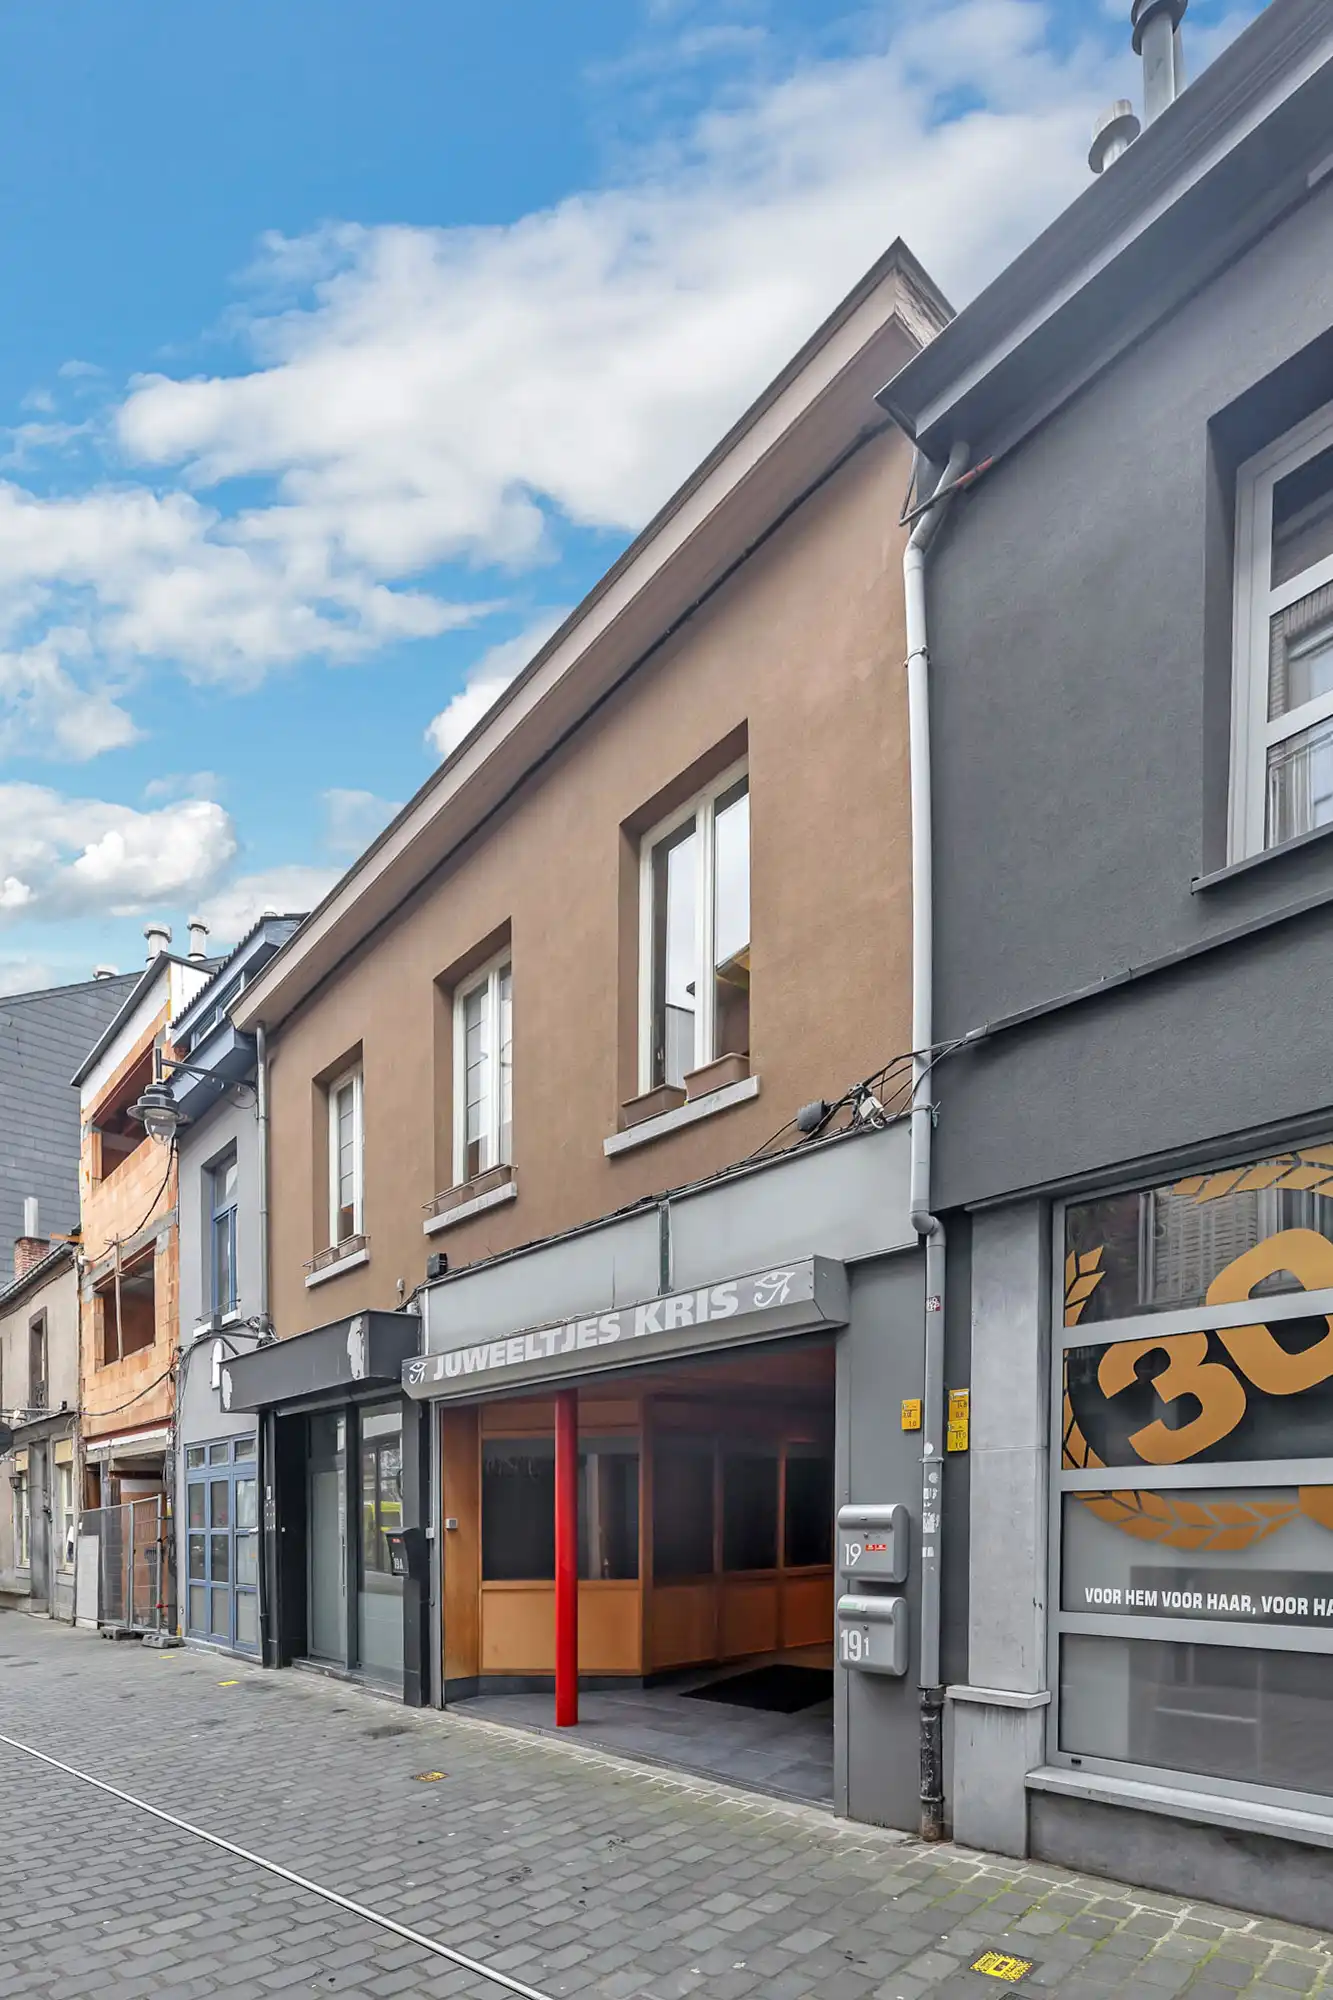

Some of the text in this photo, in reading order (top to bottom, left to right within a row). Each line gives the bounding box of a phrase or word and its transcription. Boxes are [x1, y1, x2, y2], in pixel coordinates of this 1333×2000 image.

[433, 1281, 739, 1381] JUWEELTJES KRIS
[845, 1543, 861, 1566] 19
[1085, 1587, 1122, 1605] VOOR
[1125, 1589, 1158, 1607] HEM
[1161, 1591, 1203, 1609] VOOR
[1207, 1593, 1257, 1615] HAAR,
[1261, 1595, 1309, 1616] VOOR
[840, 1629, 862, 1661] 19
